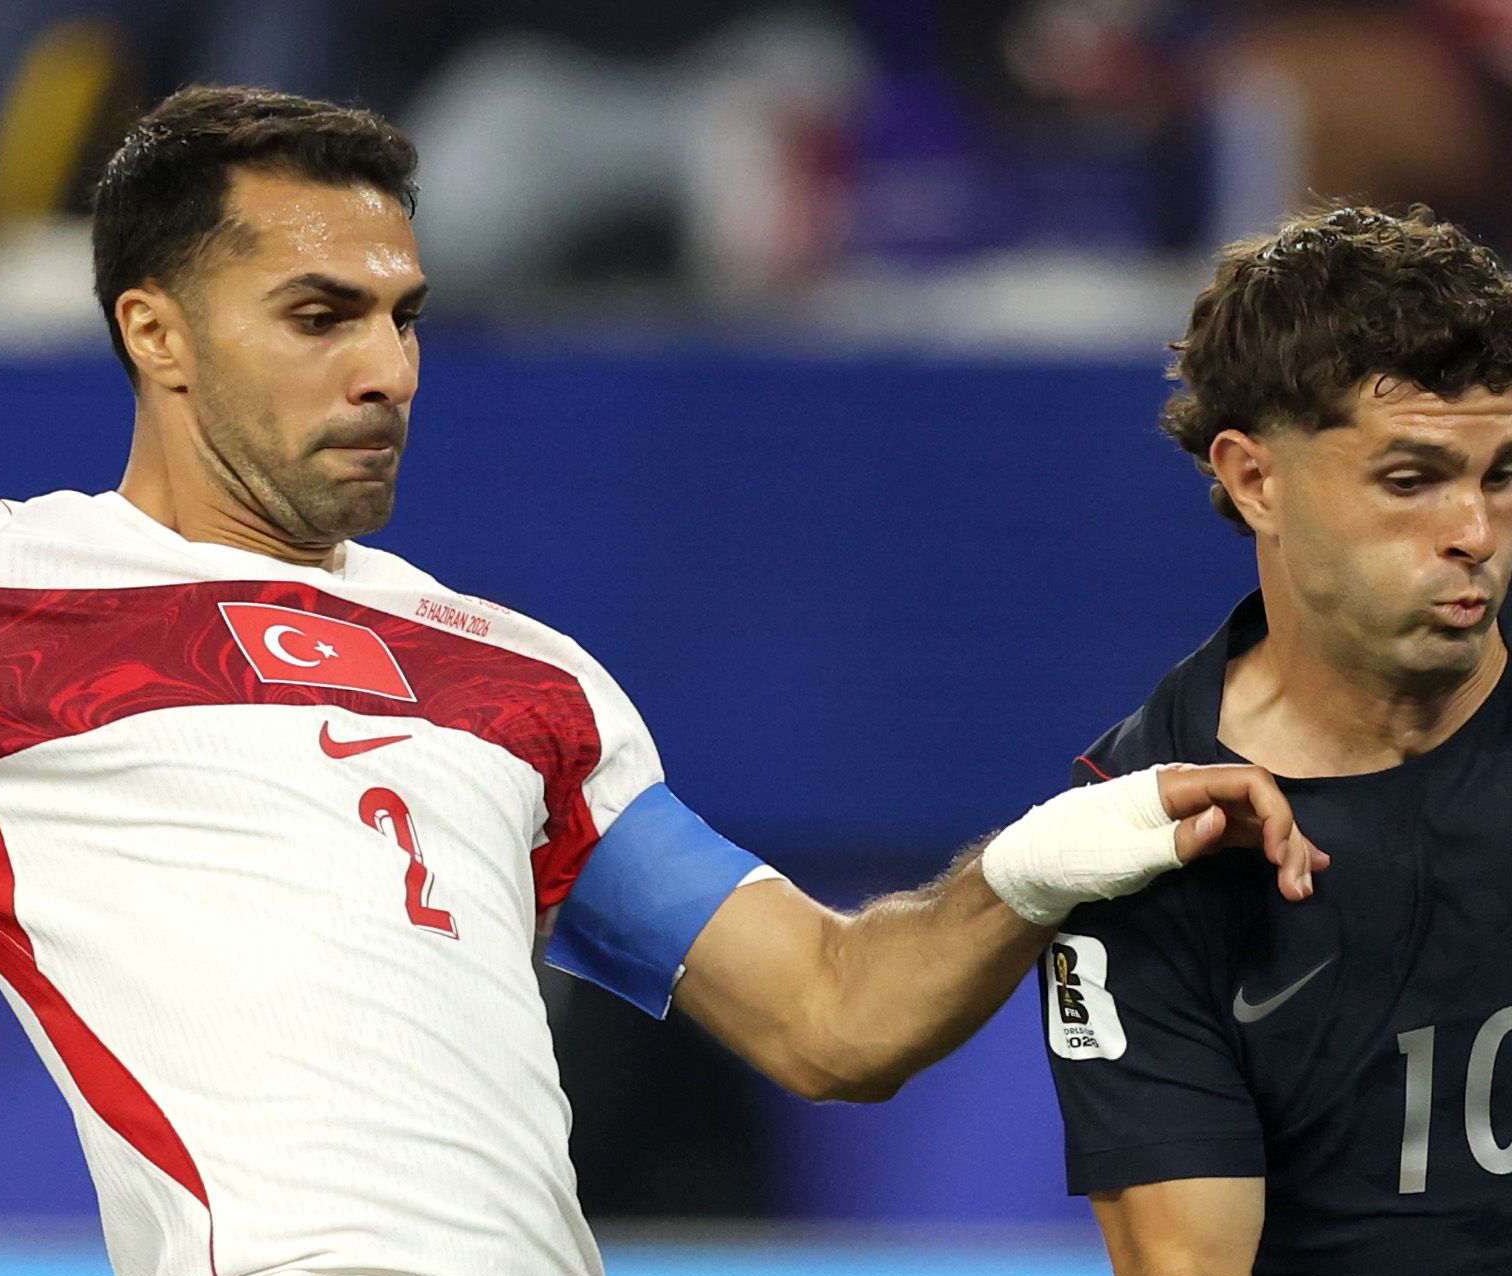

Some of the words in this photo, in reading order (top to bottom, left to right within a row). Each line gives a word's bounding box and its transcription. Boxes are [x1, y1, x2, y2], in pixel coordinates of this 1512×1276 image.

[416, 598, 429, 617] 25
[466, 616, 491, 637] 2026
[359, 787, 459, 940] 2
